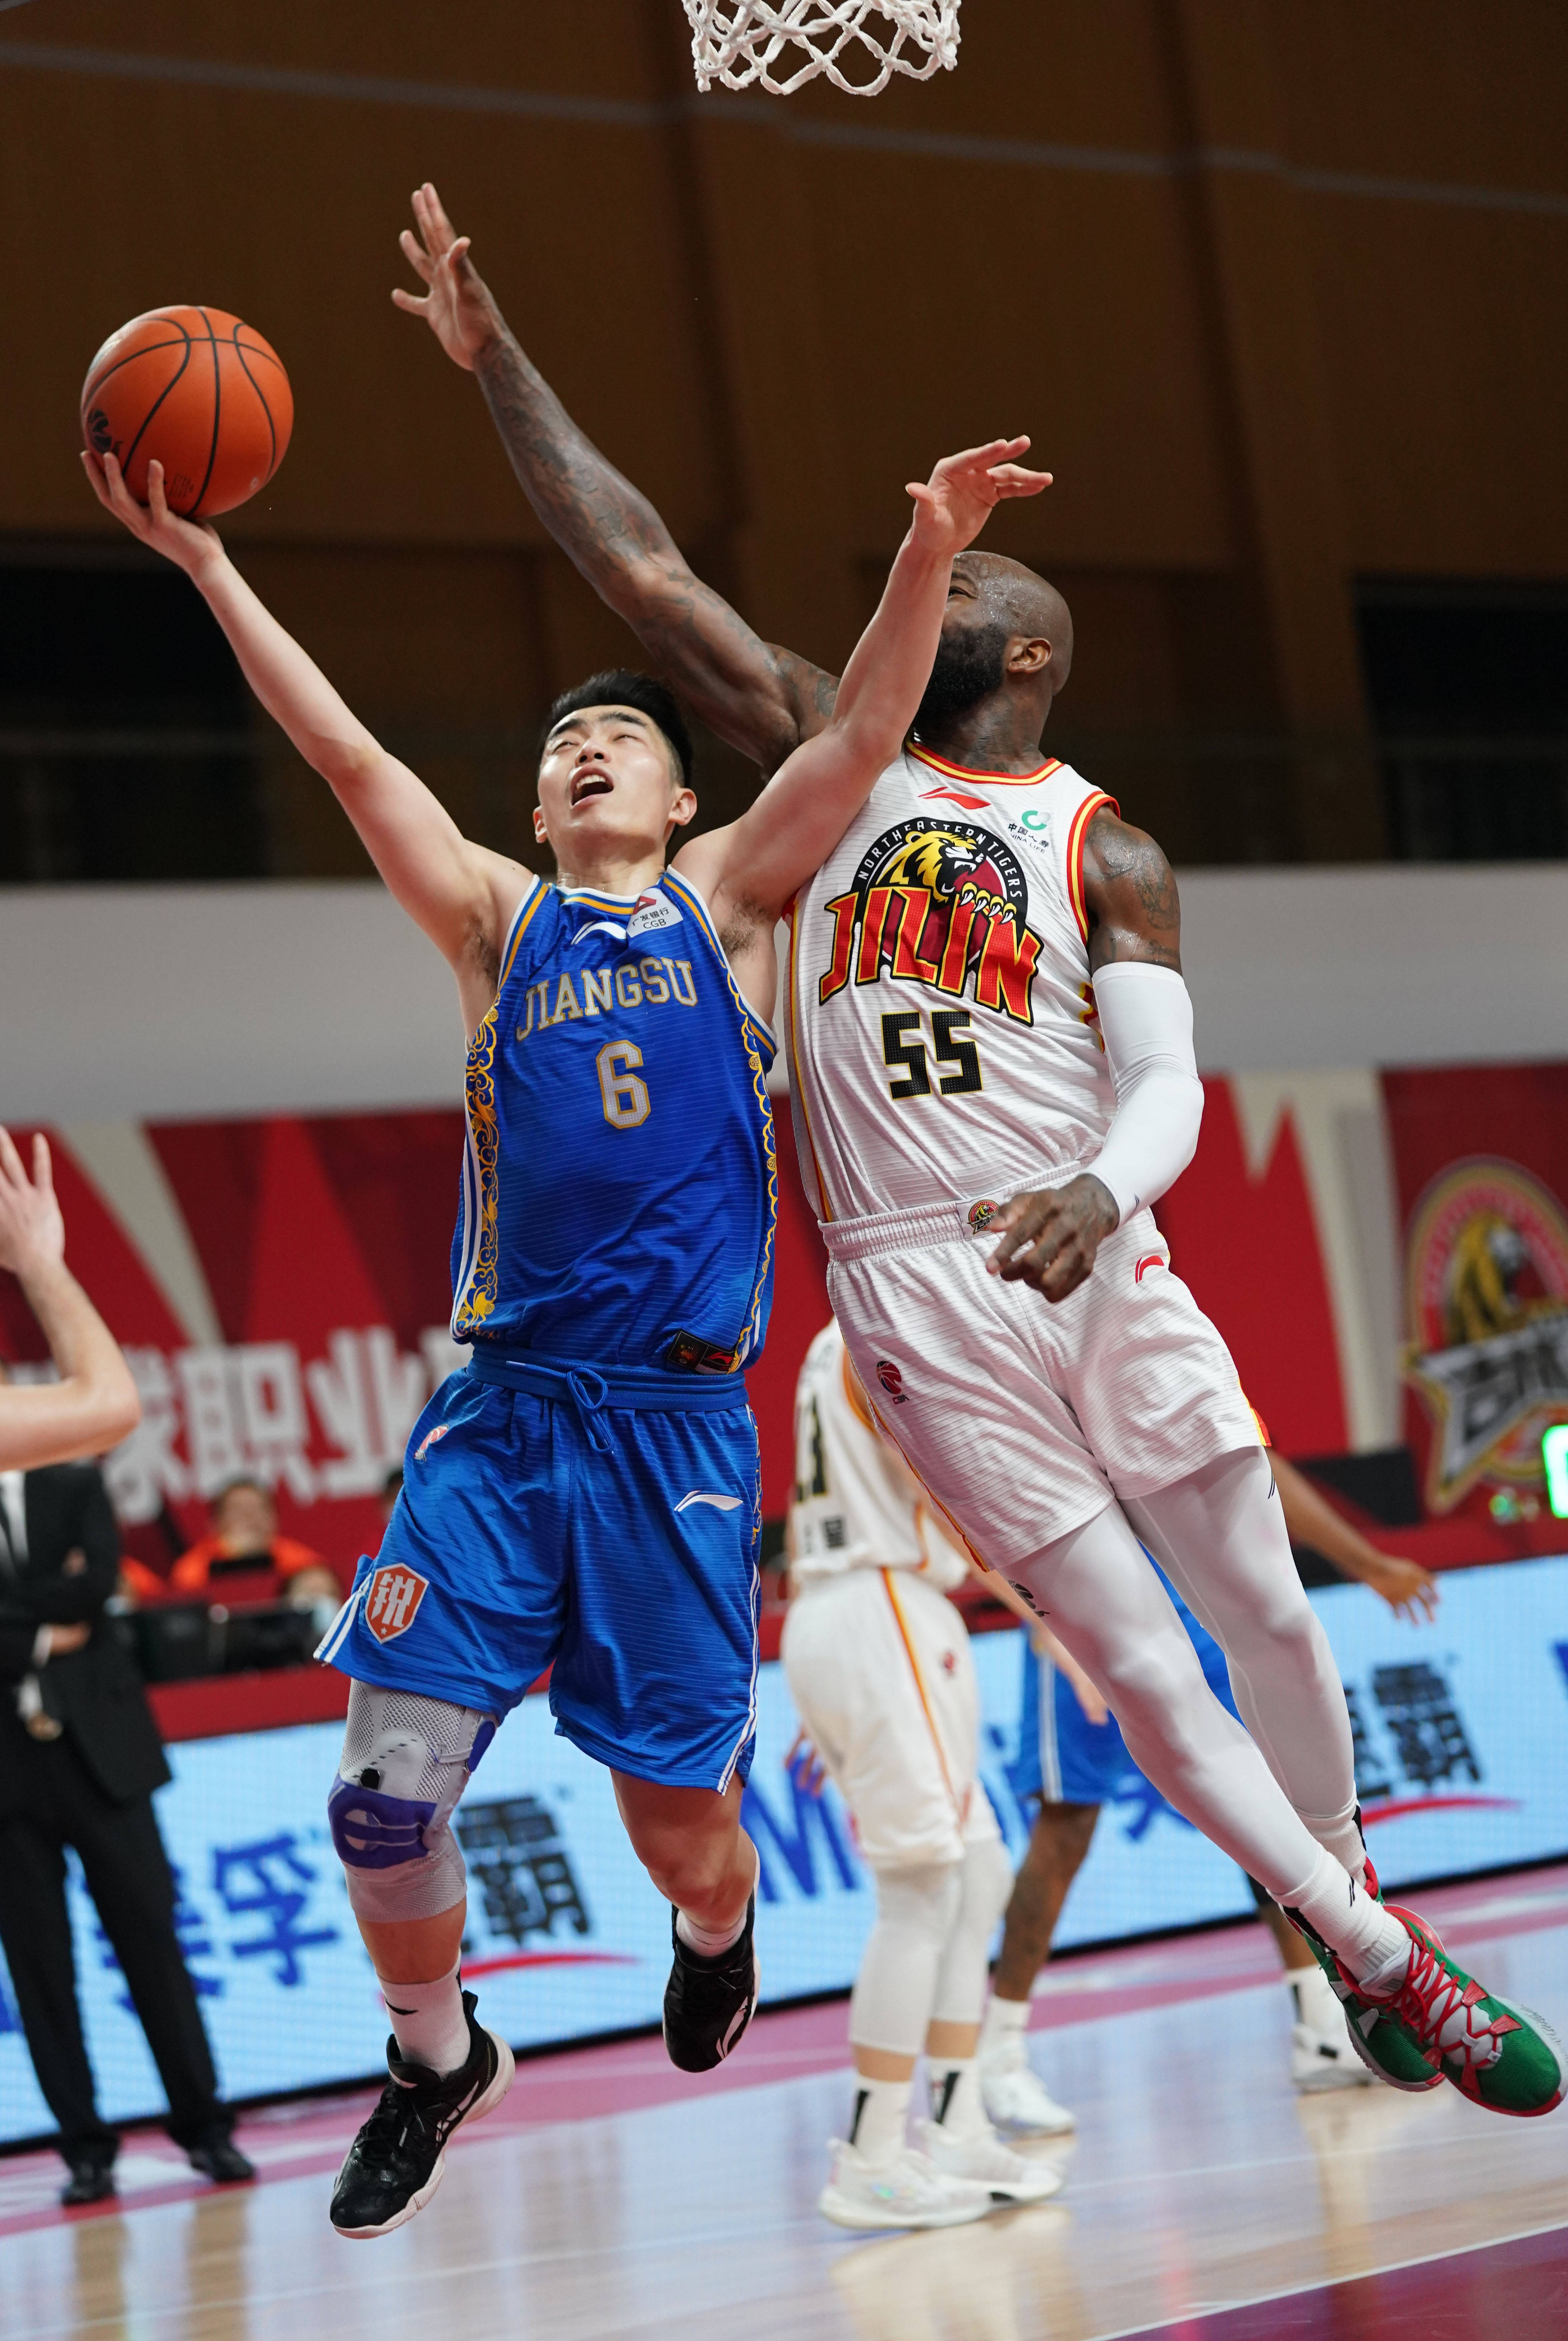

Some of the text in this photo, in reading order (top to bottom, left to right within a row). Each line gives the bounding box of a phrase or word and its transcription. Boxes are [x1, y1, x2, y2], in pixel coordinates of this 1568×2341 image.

[858, 820, 1022, 897] NORTHEASTERN TIGERS
[1008, 823, 1049, 847] 中国人寿
[1010, 833, 1046, 853] HINA LIFE
[632, 907, 669, 927] 广发银行
[643, 919, 666, 929] CGB
[819, 886, 1045, 1027] JILIN
[516, 957, 698, 1041] JIANGSU
[596, 1039, 651, 1130] 6
[881, 1009, 983, 1100] 55
[371, 1572, 417, 1628] 锐
